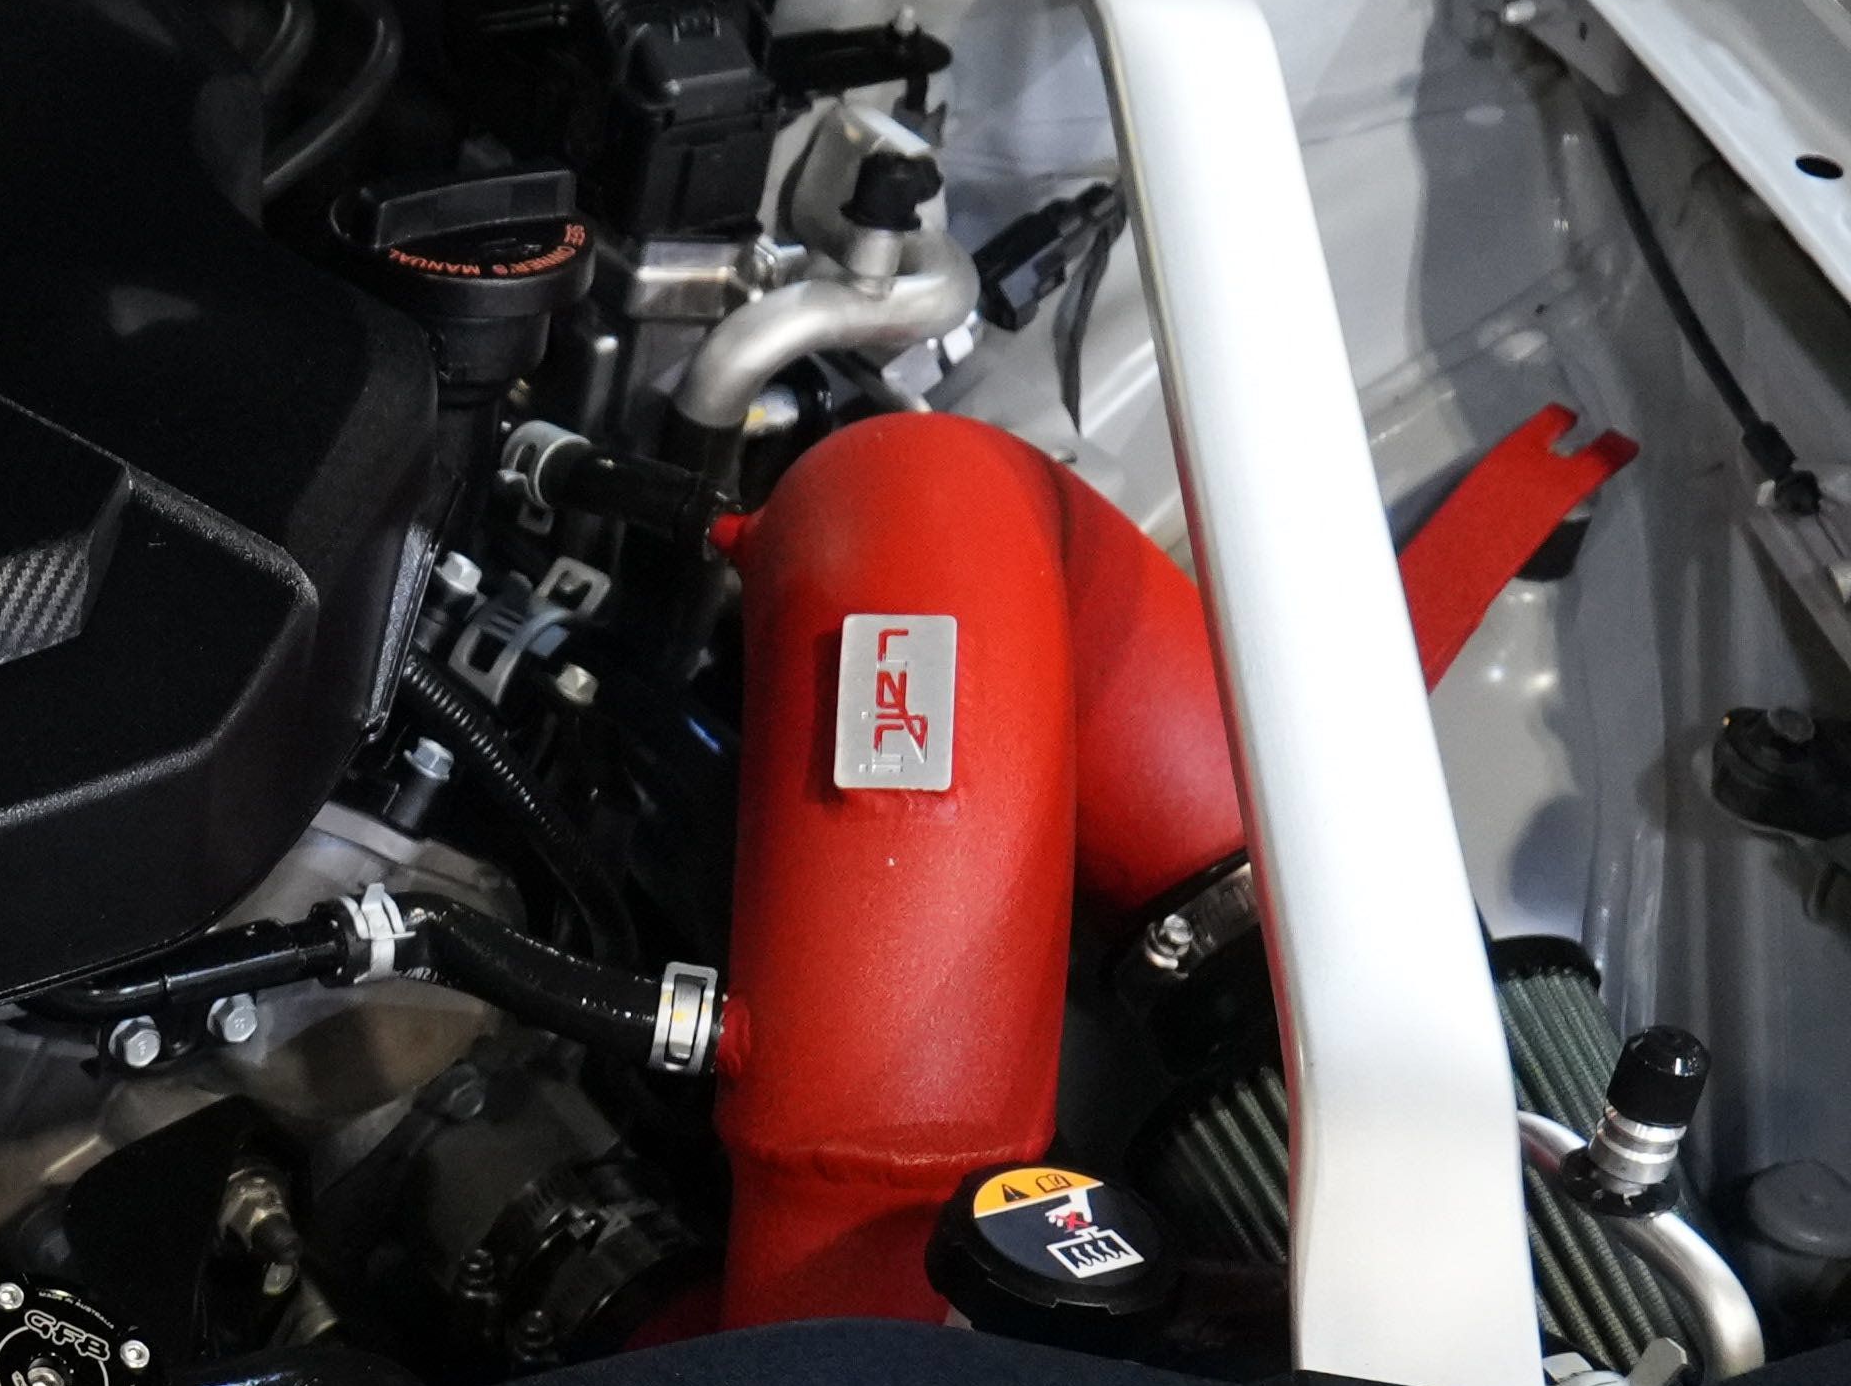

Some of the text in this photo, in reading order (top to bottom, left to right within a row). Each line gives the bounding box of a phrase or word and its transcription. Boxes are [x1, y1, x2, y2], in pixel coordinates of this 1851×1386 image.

[389, 247, 481, 276] MANUAL
[75, 1299, 114, 1329] AUSTRALIA
[24, 1309, 111, 1361] GFB
